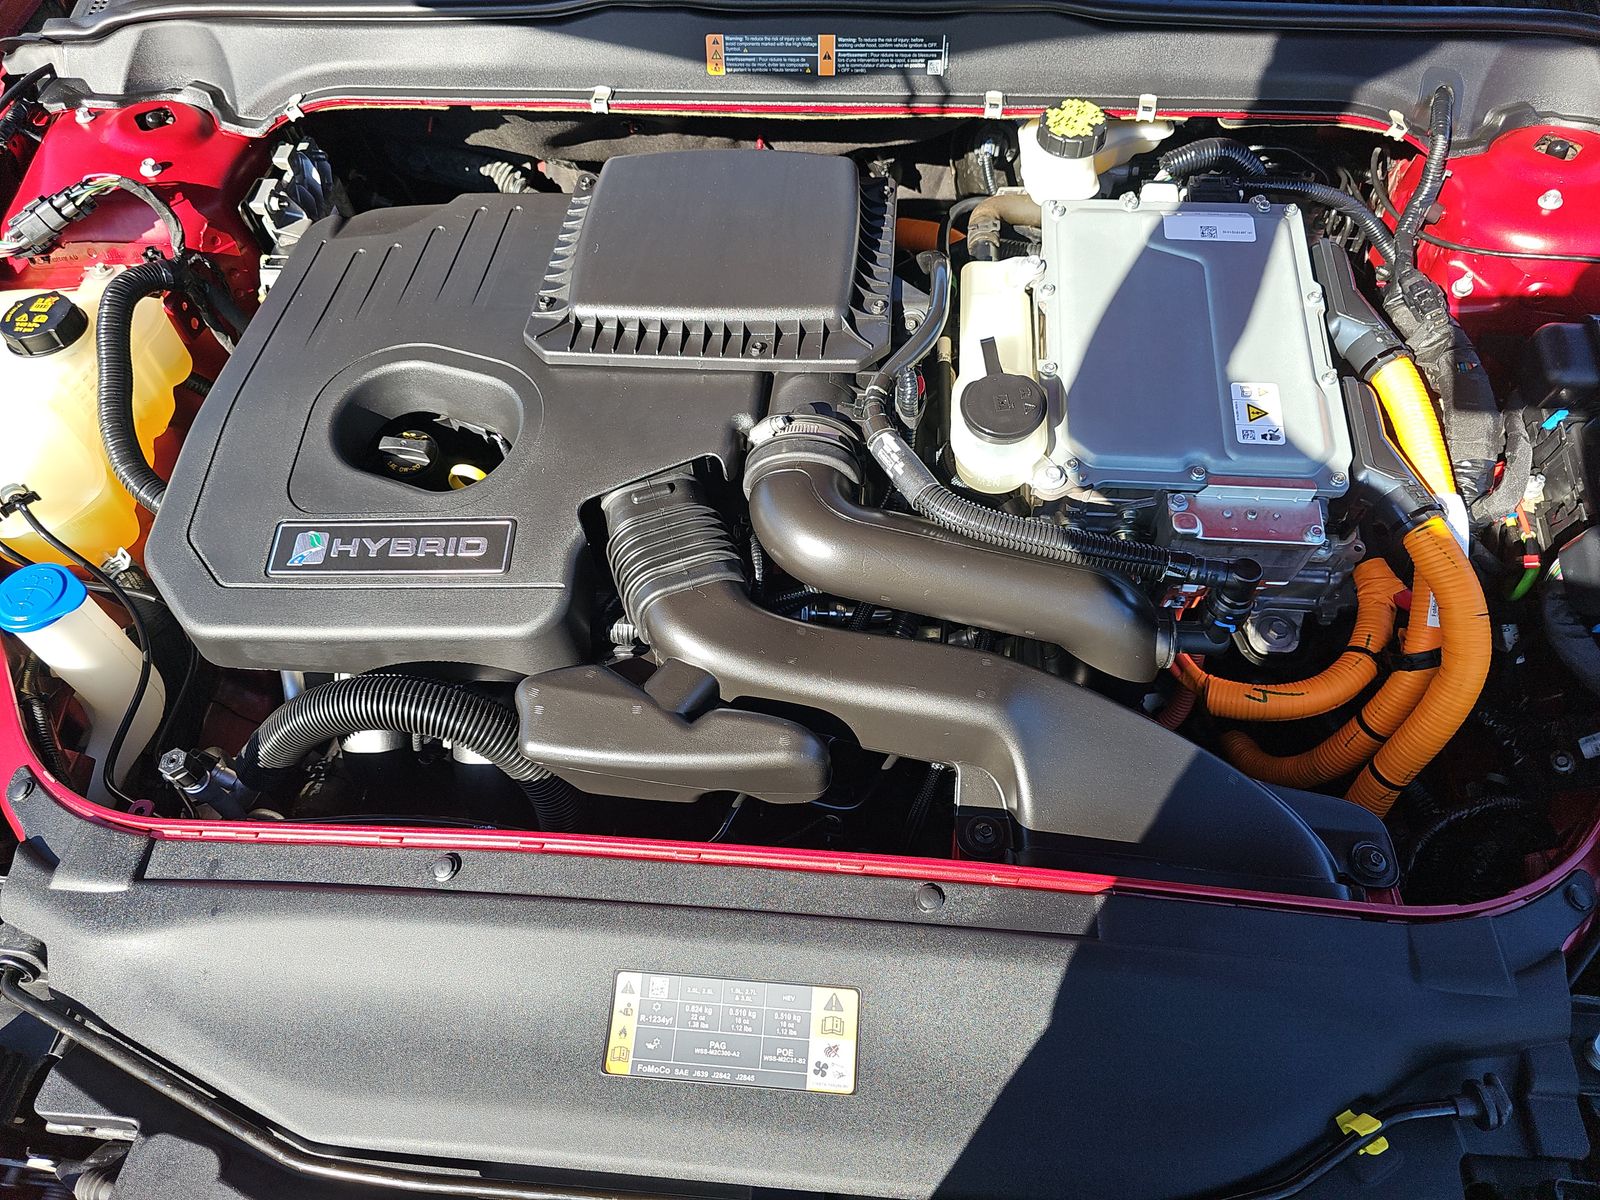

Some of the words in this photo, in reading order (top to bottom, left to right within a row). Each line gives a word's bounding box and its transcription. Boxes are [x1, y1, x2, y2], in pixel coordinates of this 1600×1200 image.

[330, 536, 489, 558] HYBRID
[685, 1005, 702, 1013] 0.624
[704, 1006, 712, 1015] kg
[729, 1008, 746, 1016] 0.510
[748, 1010, 756, 1019] kg
[640, 1014, 673, 1025] R-1234yf
[774, 1012, 792, 1020] 0.510
[793, 1014, 801, 1023] kg
[709, 1041, 727, 1050] PAG
[777, 1048, 794, 1056] POE
[637, 1064, 670, 1074] FoMoCo
[692, 1070, 708, 1078] J639
